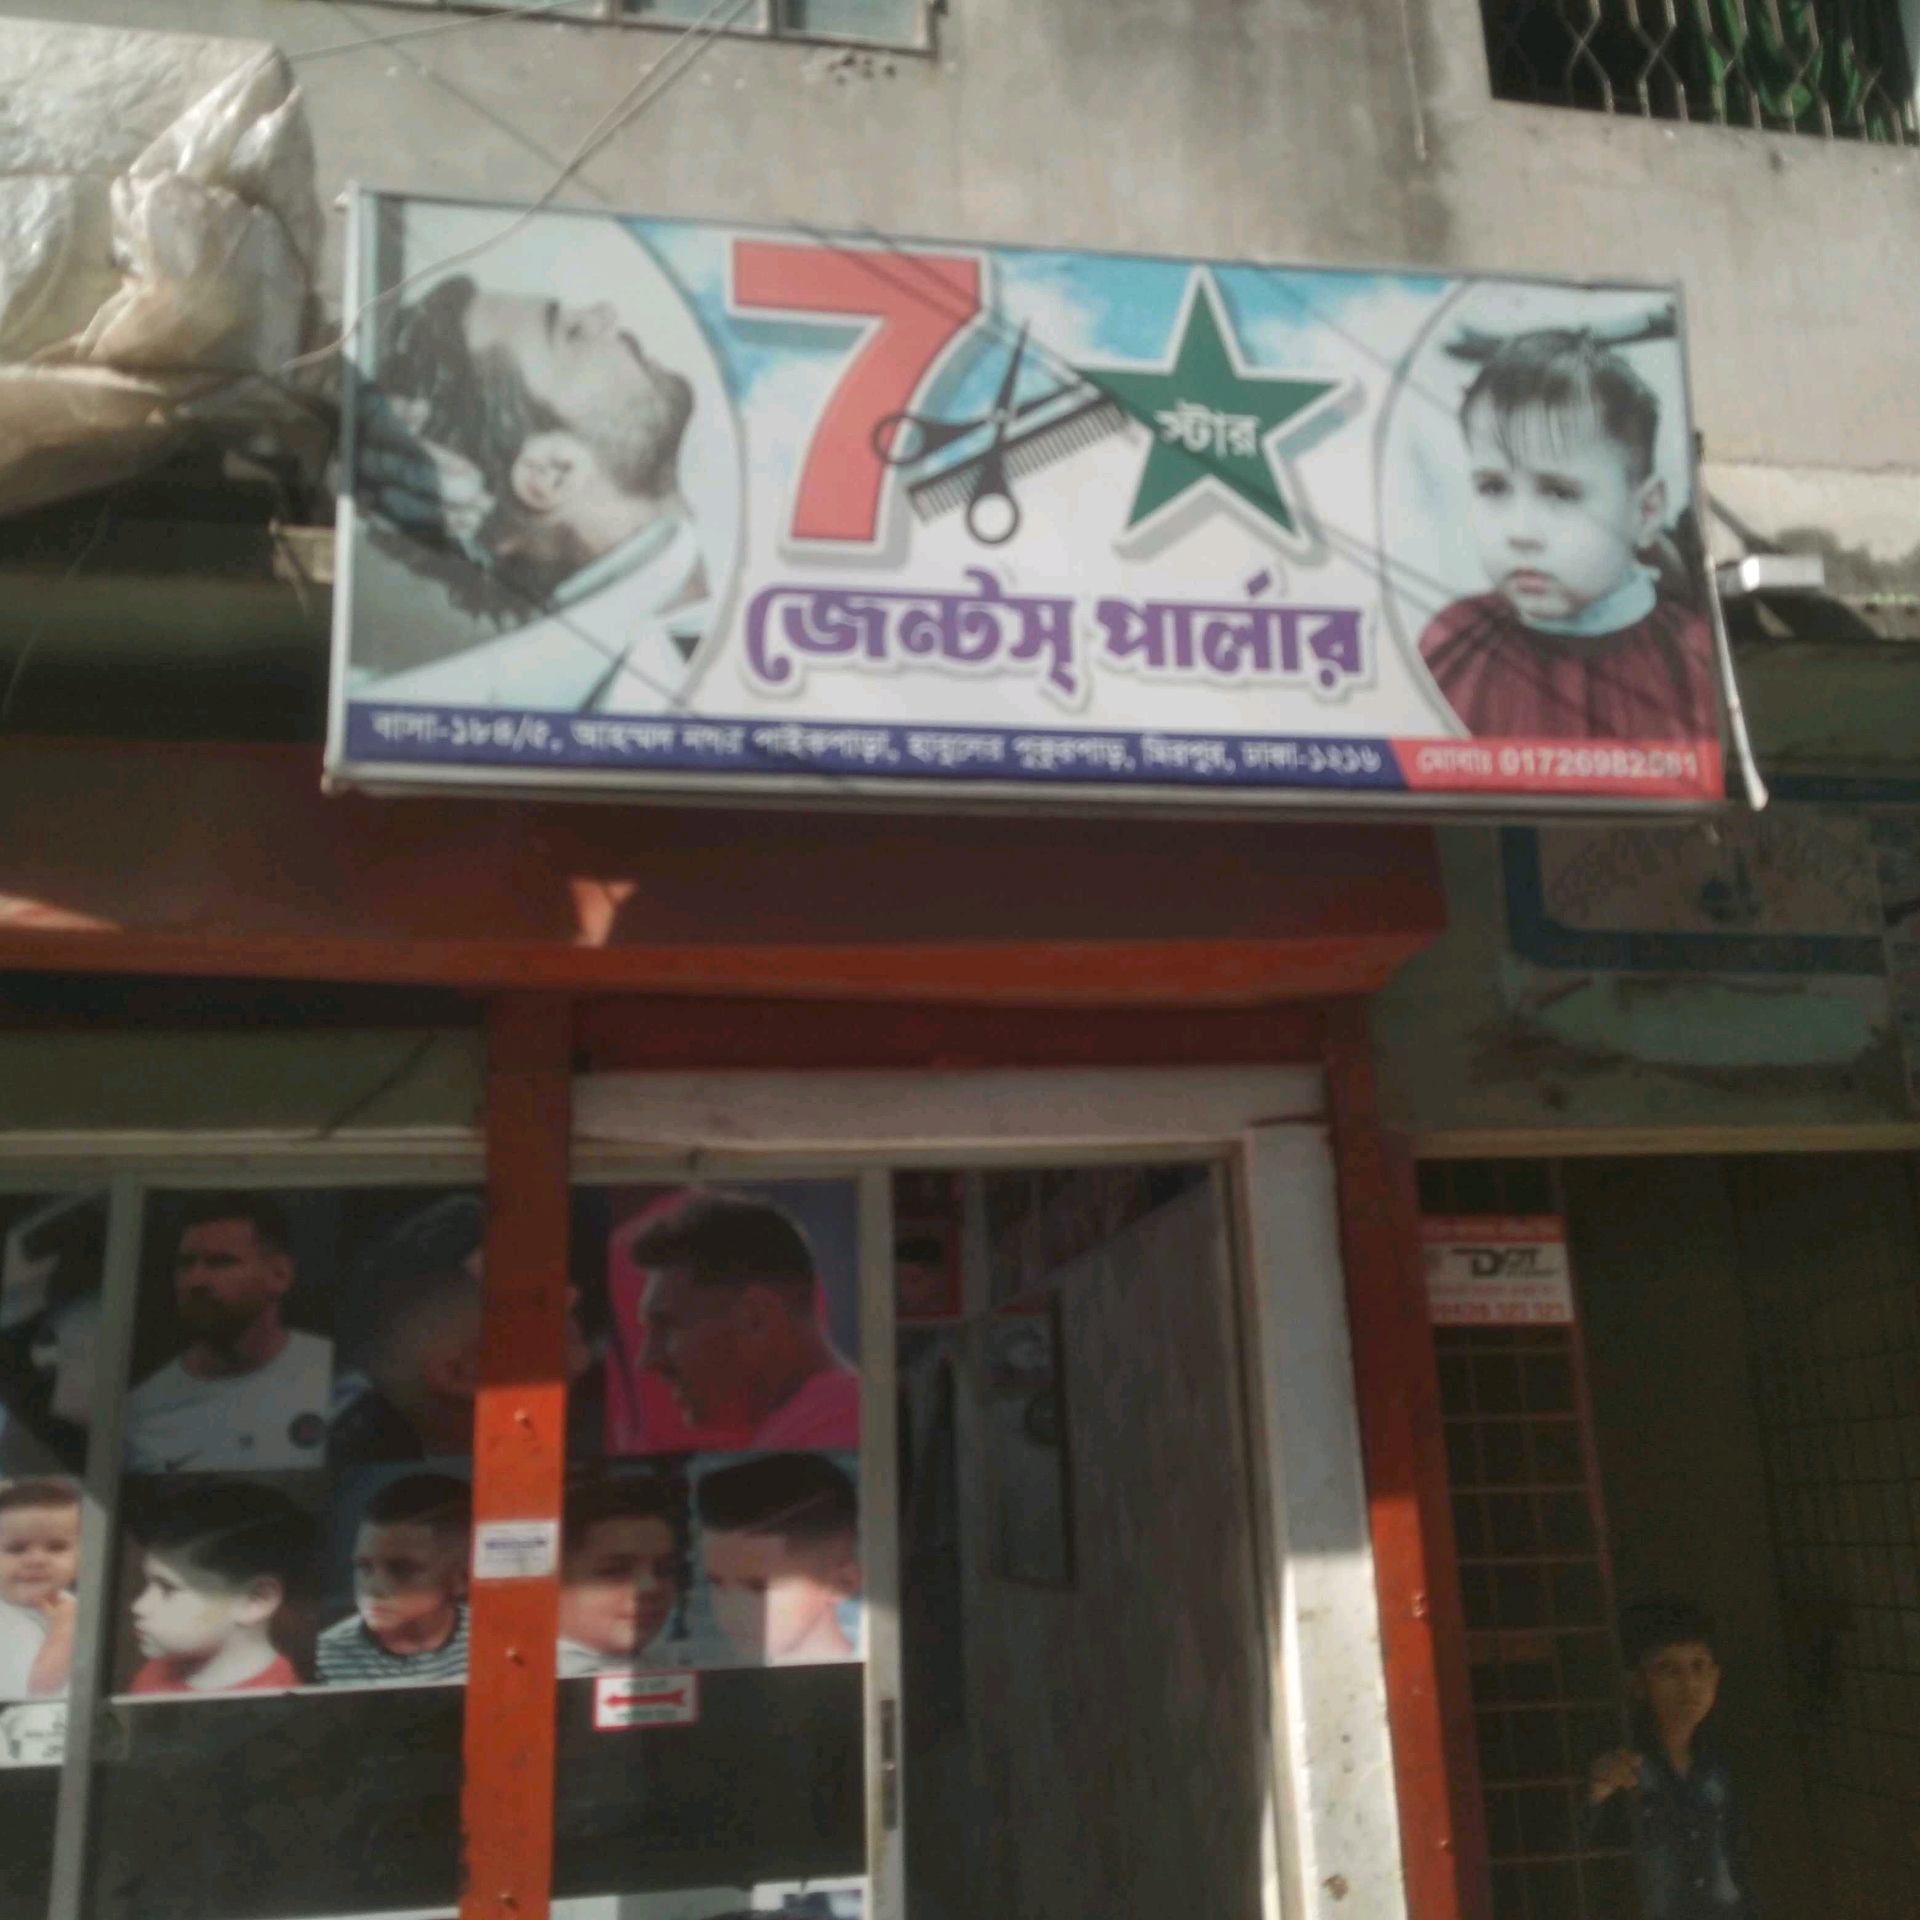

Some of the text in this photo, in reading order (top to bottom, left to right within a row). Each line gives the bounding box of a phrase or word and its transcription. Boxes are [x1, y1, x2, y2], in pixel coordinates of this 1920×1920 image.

[731, 239, 984, 543] 7
[1154, 402, 1262, 457] স্টার
[745, 567, 1362, 696] জেন্টস্ পার্লার
